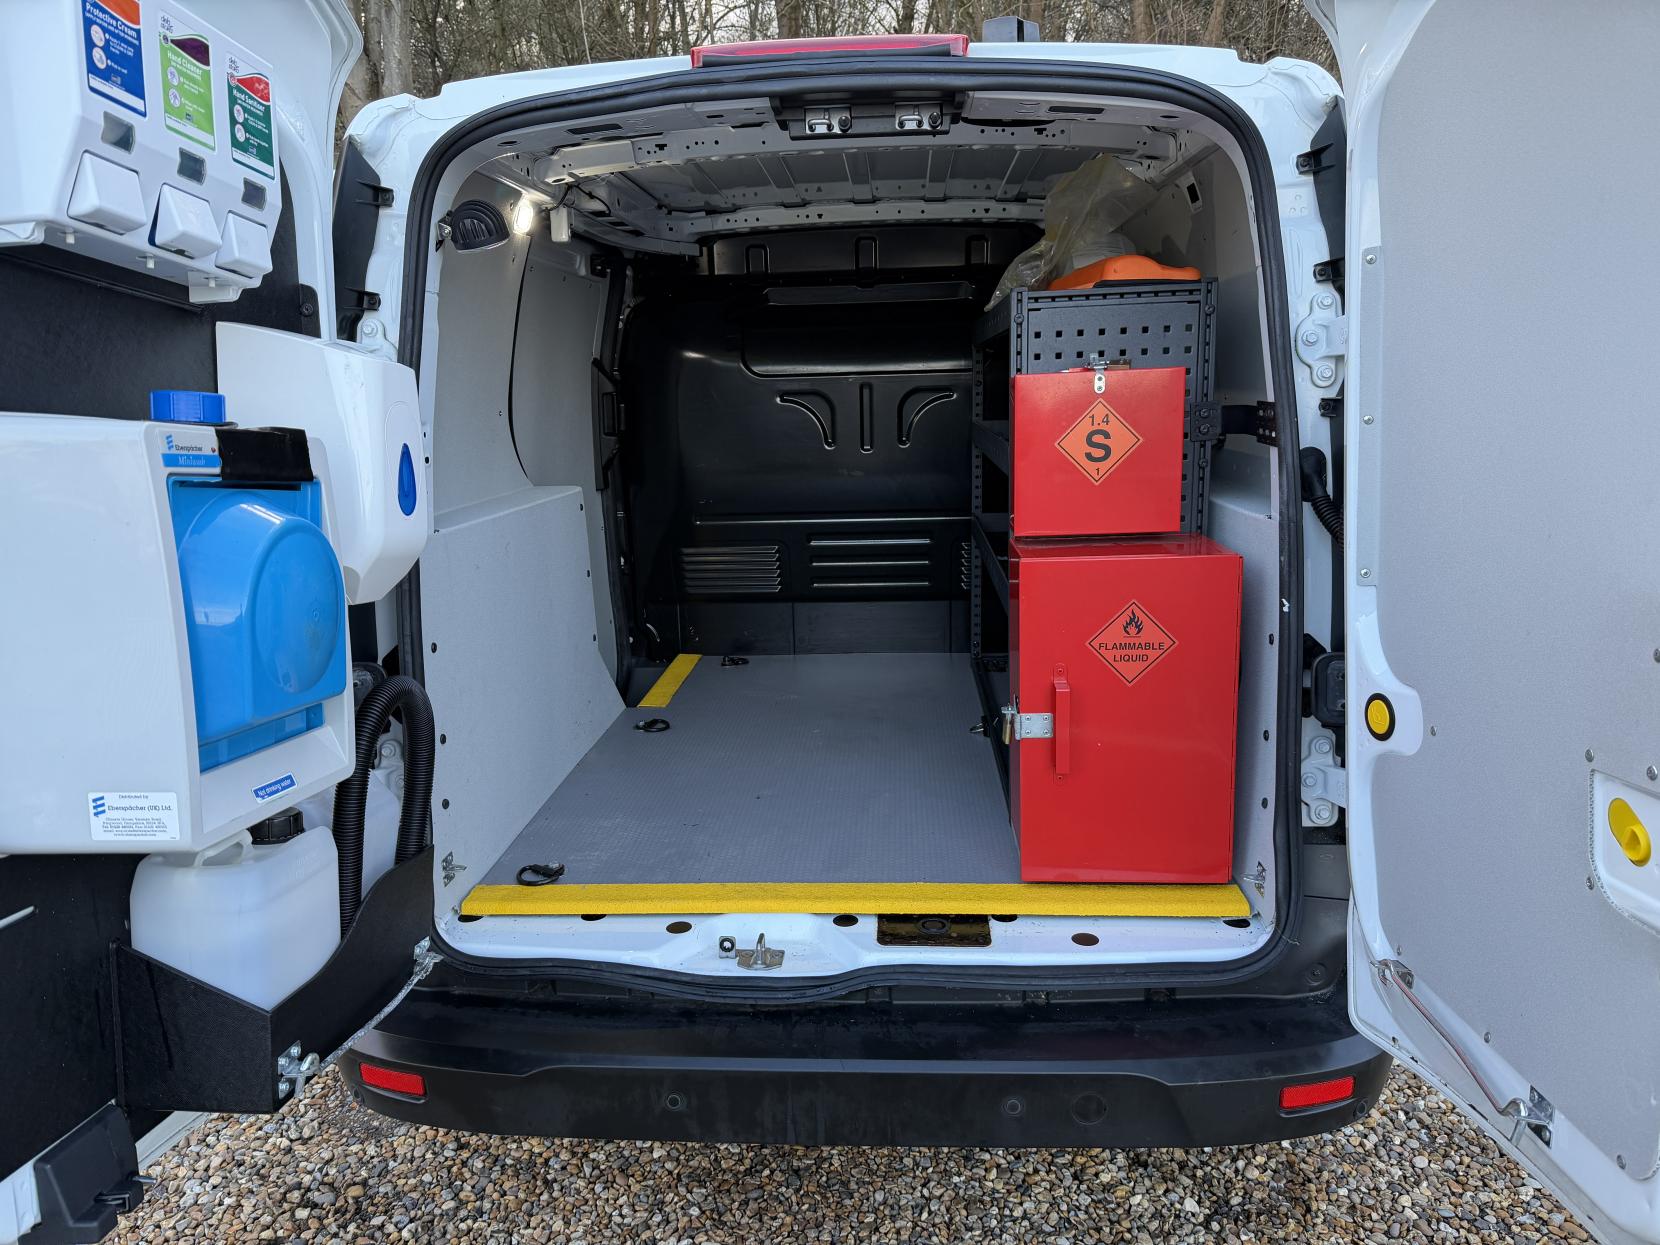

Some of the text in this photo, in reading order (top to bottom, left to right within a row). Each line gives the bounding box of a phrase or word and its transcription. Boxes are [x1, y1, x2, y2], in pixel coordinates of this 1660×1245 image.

[86, 2, 117, 27] Protective
[118, 21, 137, 39] Cream
[167, 50, 182, 65] Hand
[182, 59, 203, 76] Cleaner
[233, 88, 245, 101] Hand
[1088, 413, 1110, 426] 1.4
[1084, 428, 1112, 463] S
[1095, 467, 1100, 476] 1
[1098, 642, 1165, 651] FLAMMABLE
[1113, 654, 1149, 662] LIQUID
[147, 804, 160, 812] (UK)
